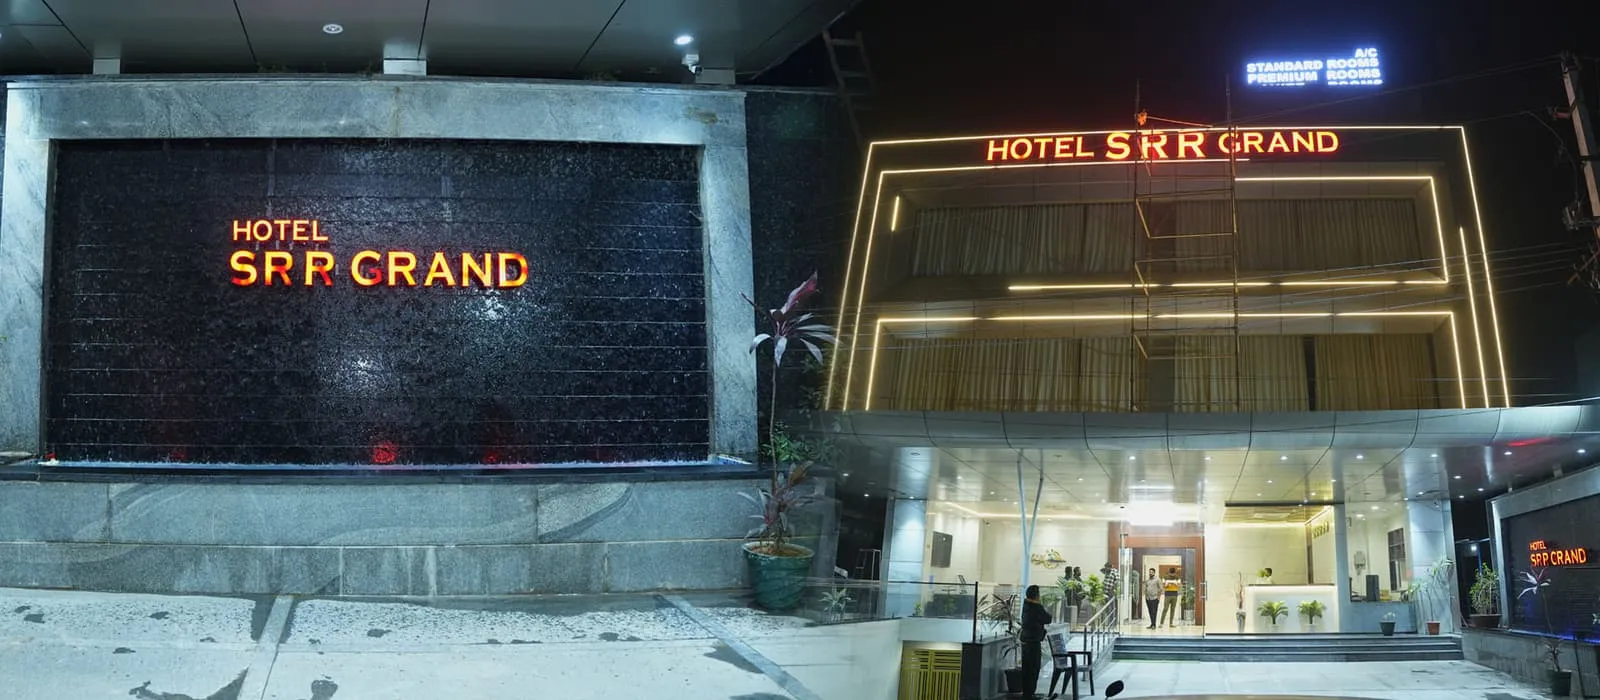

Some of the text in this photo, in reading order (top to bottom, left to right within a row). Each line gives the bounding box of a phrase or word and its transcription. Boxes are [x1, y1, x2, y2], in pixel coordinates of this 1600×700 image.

[1355, 48, 1378, 58] A/C
[1246, 58, 1380, 72] STANDARD ROOMS
[1247, 71, 1318, 84] PREMIUM
[1326, 69, 1381, 80] ROOMS
[986, 136, 1095, 161] HOTEL
[1218, 130, 1340, 153] GRAND
[232, 219, 329, 242] HOTEL
[350, 250, 530, 288] GRAND
[1529, 540, 1547, 551] HOTEL
